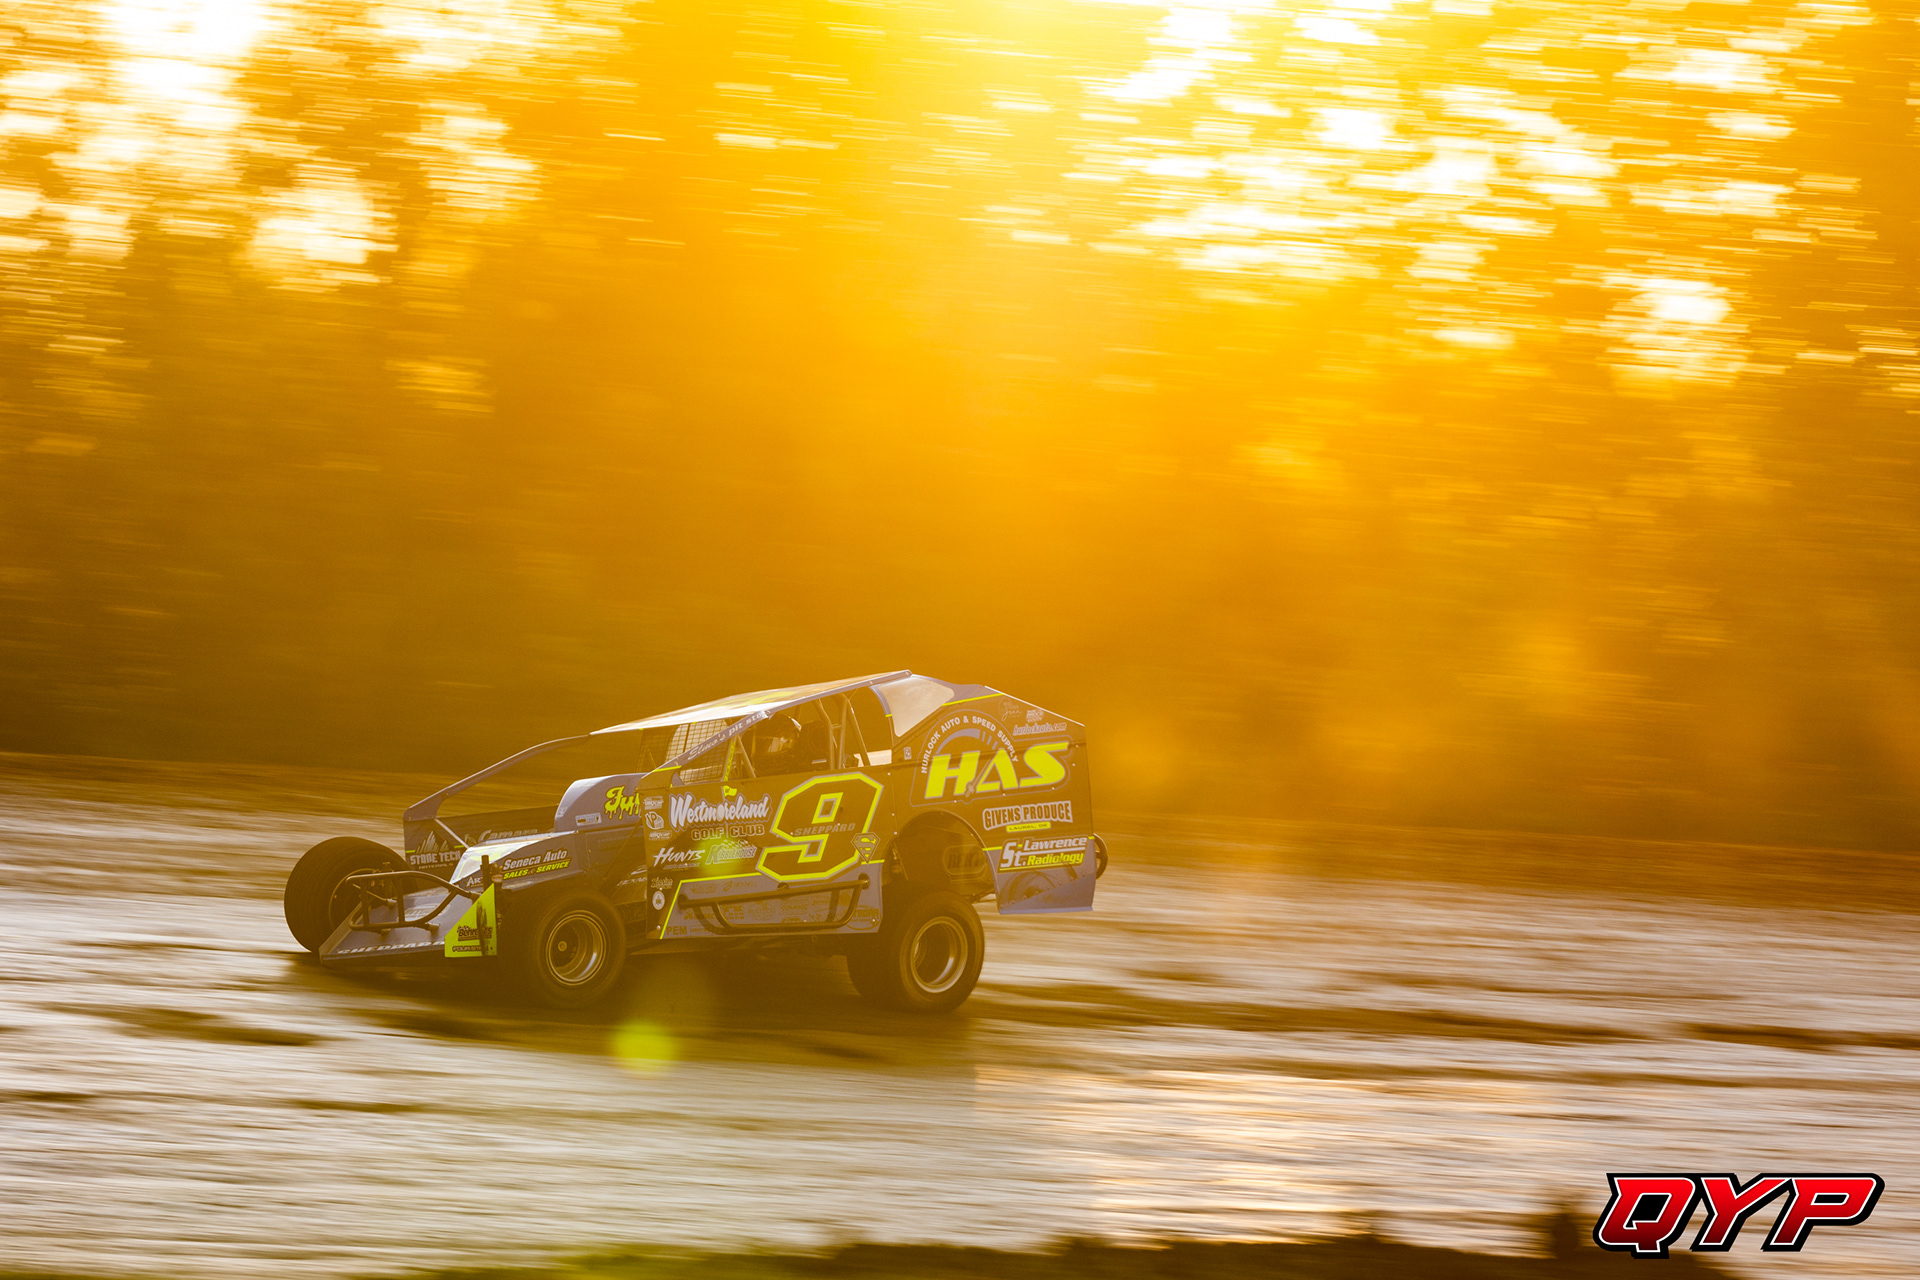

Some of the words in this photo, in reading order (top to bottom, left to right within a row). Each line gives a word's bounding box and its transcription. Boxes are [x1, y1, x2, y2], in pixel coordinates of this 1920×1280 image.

[728, 723, 744, 737] pit
[921, 730, 941, 774] HURLOCK
[940, 716, 961, 734] AUTO
[962, 714, 970, 724] &
[971, 715, 997, 732] SPEED
[996, 729, 1019, 763] SUPPLY
[924, 741, 1069, 799] HAS
[669, 792, 770, 830] Westmoreland
[983, 807, 1021, 830] GIVENS
[1022, 801, 1072, 822] PRODUCE
[691, 828, 725, 842] GOLF
[729, 824, 765, 838] CLUB
[755, 772, 884, 882] 9
[794, 822, 856, 836] SHEPPARD
[410, 853, 438, 865] STONE
[439, 850, 461, 862] TECH
[503, 855, 542, 870] Seneca
[543, 849, 568, 863] Auto
[1000, 841, 1027, 868] St.
[1023, 837, 1088, 852] Lawrence
[1027, 853, 1084, 866] Radiology
[503, 868, 529, 880] SALES
[536, 861, 570, 873] SERVICE
[666, 925, 688, 936] PEM
